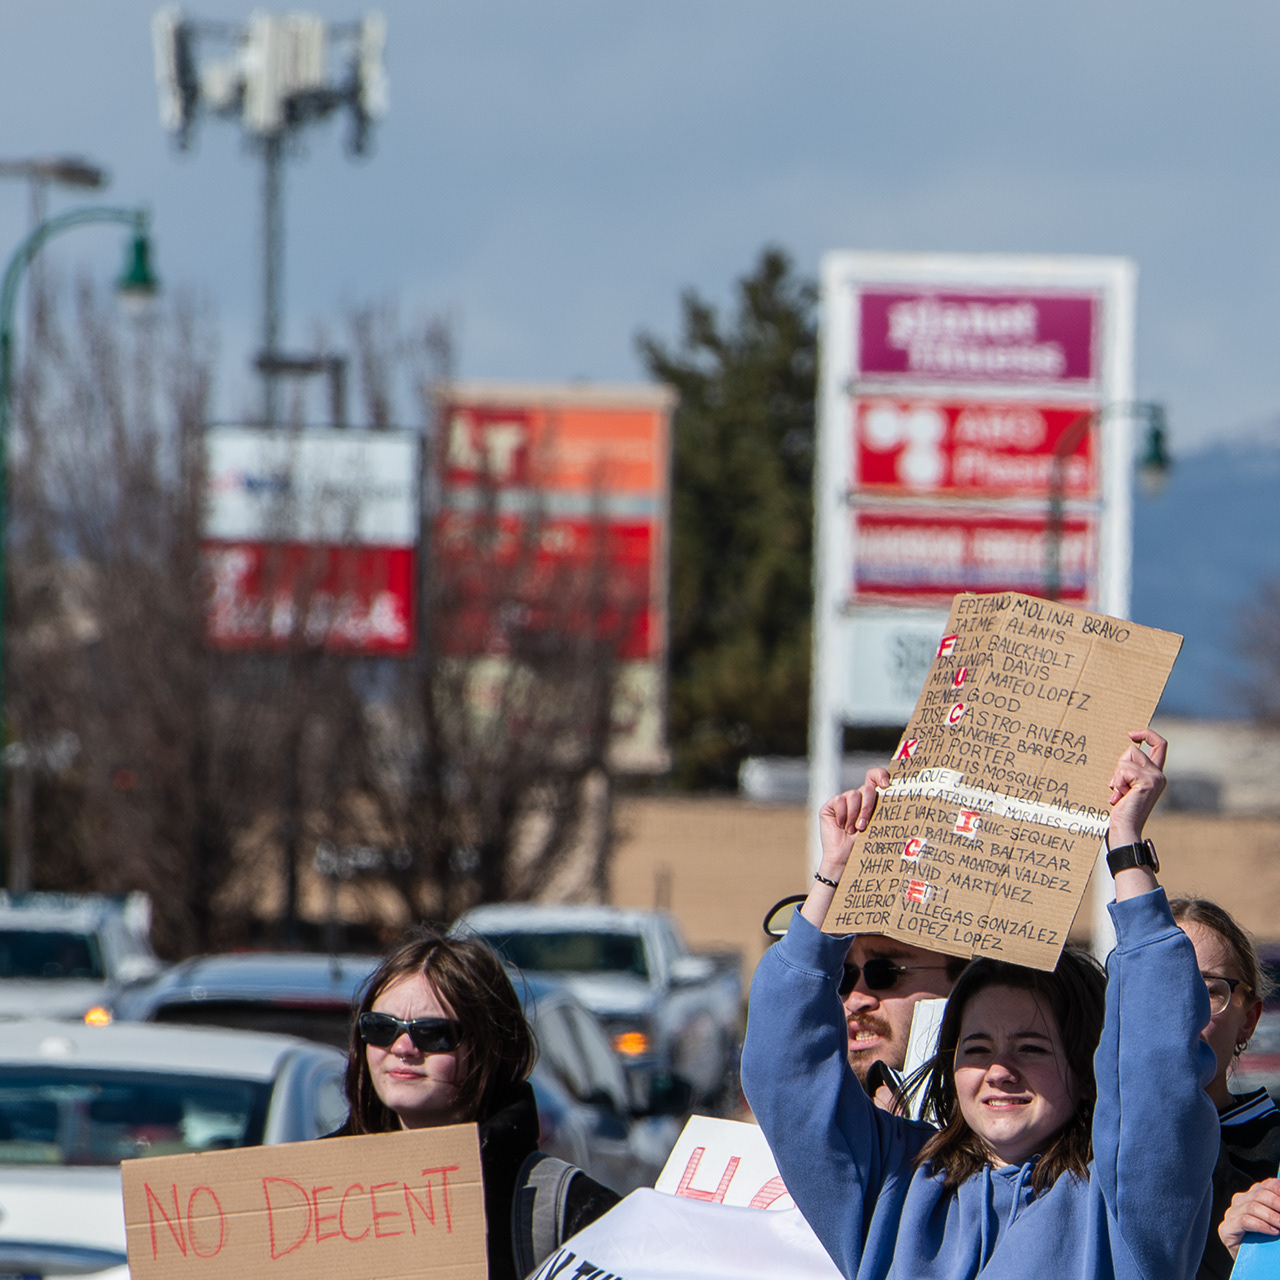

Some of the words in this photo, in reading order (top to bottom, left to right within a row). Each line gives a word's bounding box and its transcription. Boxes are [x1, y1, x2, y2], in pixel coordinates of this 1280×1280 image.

[952, 616, 996, 633] JAIME
[1005, 617, 1067, 645] ALANIS
[957, 595, 1012, 614] EPIFANO
[1012, 598, 1075, 627] MOLINA
[1082, 615, 1131, 643] BRAVO
[936, 634, 981, 659] FELIX
[987, 634, 1075, 669] BAUCKHOLT
[1002, 657, 1051, 682] DAVIS
[924, 688, 964, 706] RENEE
[966, 688, 1022, 714] GOOD
[929, 667, 978, 690] MANUEL
[985, 669, 1036, 696] MATEO
[1037, 684, 1092, 712] LOPEZ
[915, 708, 950, 726] JOSE
[947, 703, 1088, 752] CASTRO-RIVERA
[949, 724, 1012, 749] SANCHEZ
[1017, 740, 1088, 766] BARBOZA
[896, 738, 944, 760] KEITH
[950, 738, 1016, 767] PORTER
[889, 769, 951, 785] ENRIQUE
[953, 774, 1000, 795] JUAN
[1004, 784, 1046, 808] TIZOL
[1050, 798, 1111, 823] MACARIO
[900, 755, 930, 771] RYAN
[932, 754, 980, 774] LOUIS
[982, 764, 1069, 798] MOSQUEDA
[882, 788, 923, 803] ELENA
[925, 788, 996, 814] CATARINA
[862, 841, 907, 855] ROBERTO
[904, 838, 956, 865] CARLOS
[958, 854, 1011, 876] MONTOYA
[1014, 866, 1073, 893] VALDEZ
[867, 825, 920, 839] BARTOLO
[923, 826, 985, 851] BALTAZAR
[990, 842, 1073, 872] BALTAZAR
[848, 878, 886, 894] ALEX
[858, 858, 895, 877] YAHIR
[899, 859, 942, 881] DAVID
[948, 872, 1034, 905] MARTINEZ
[834, 911, 891, 927] HECTOR
[896, 913, 949, 942] LOPEZ
[953, 927, 1004, 951] LOPEZ
[843, 893, 896, 910] SILVERIO
[900, 897, 975, 928] VILLEGAS
[143, 1180, 230, 1261] NO
[262, 1164, 461, 1260] DECENT
